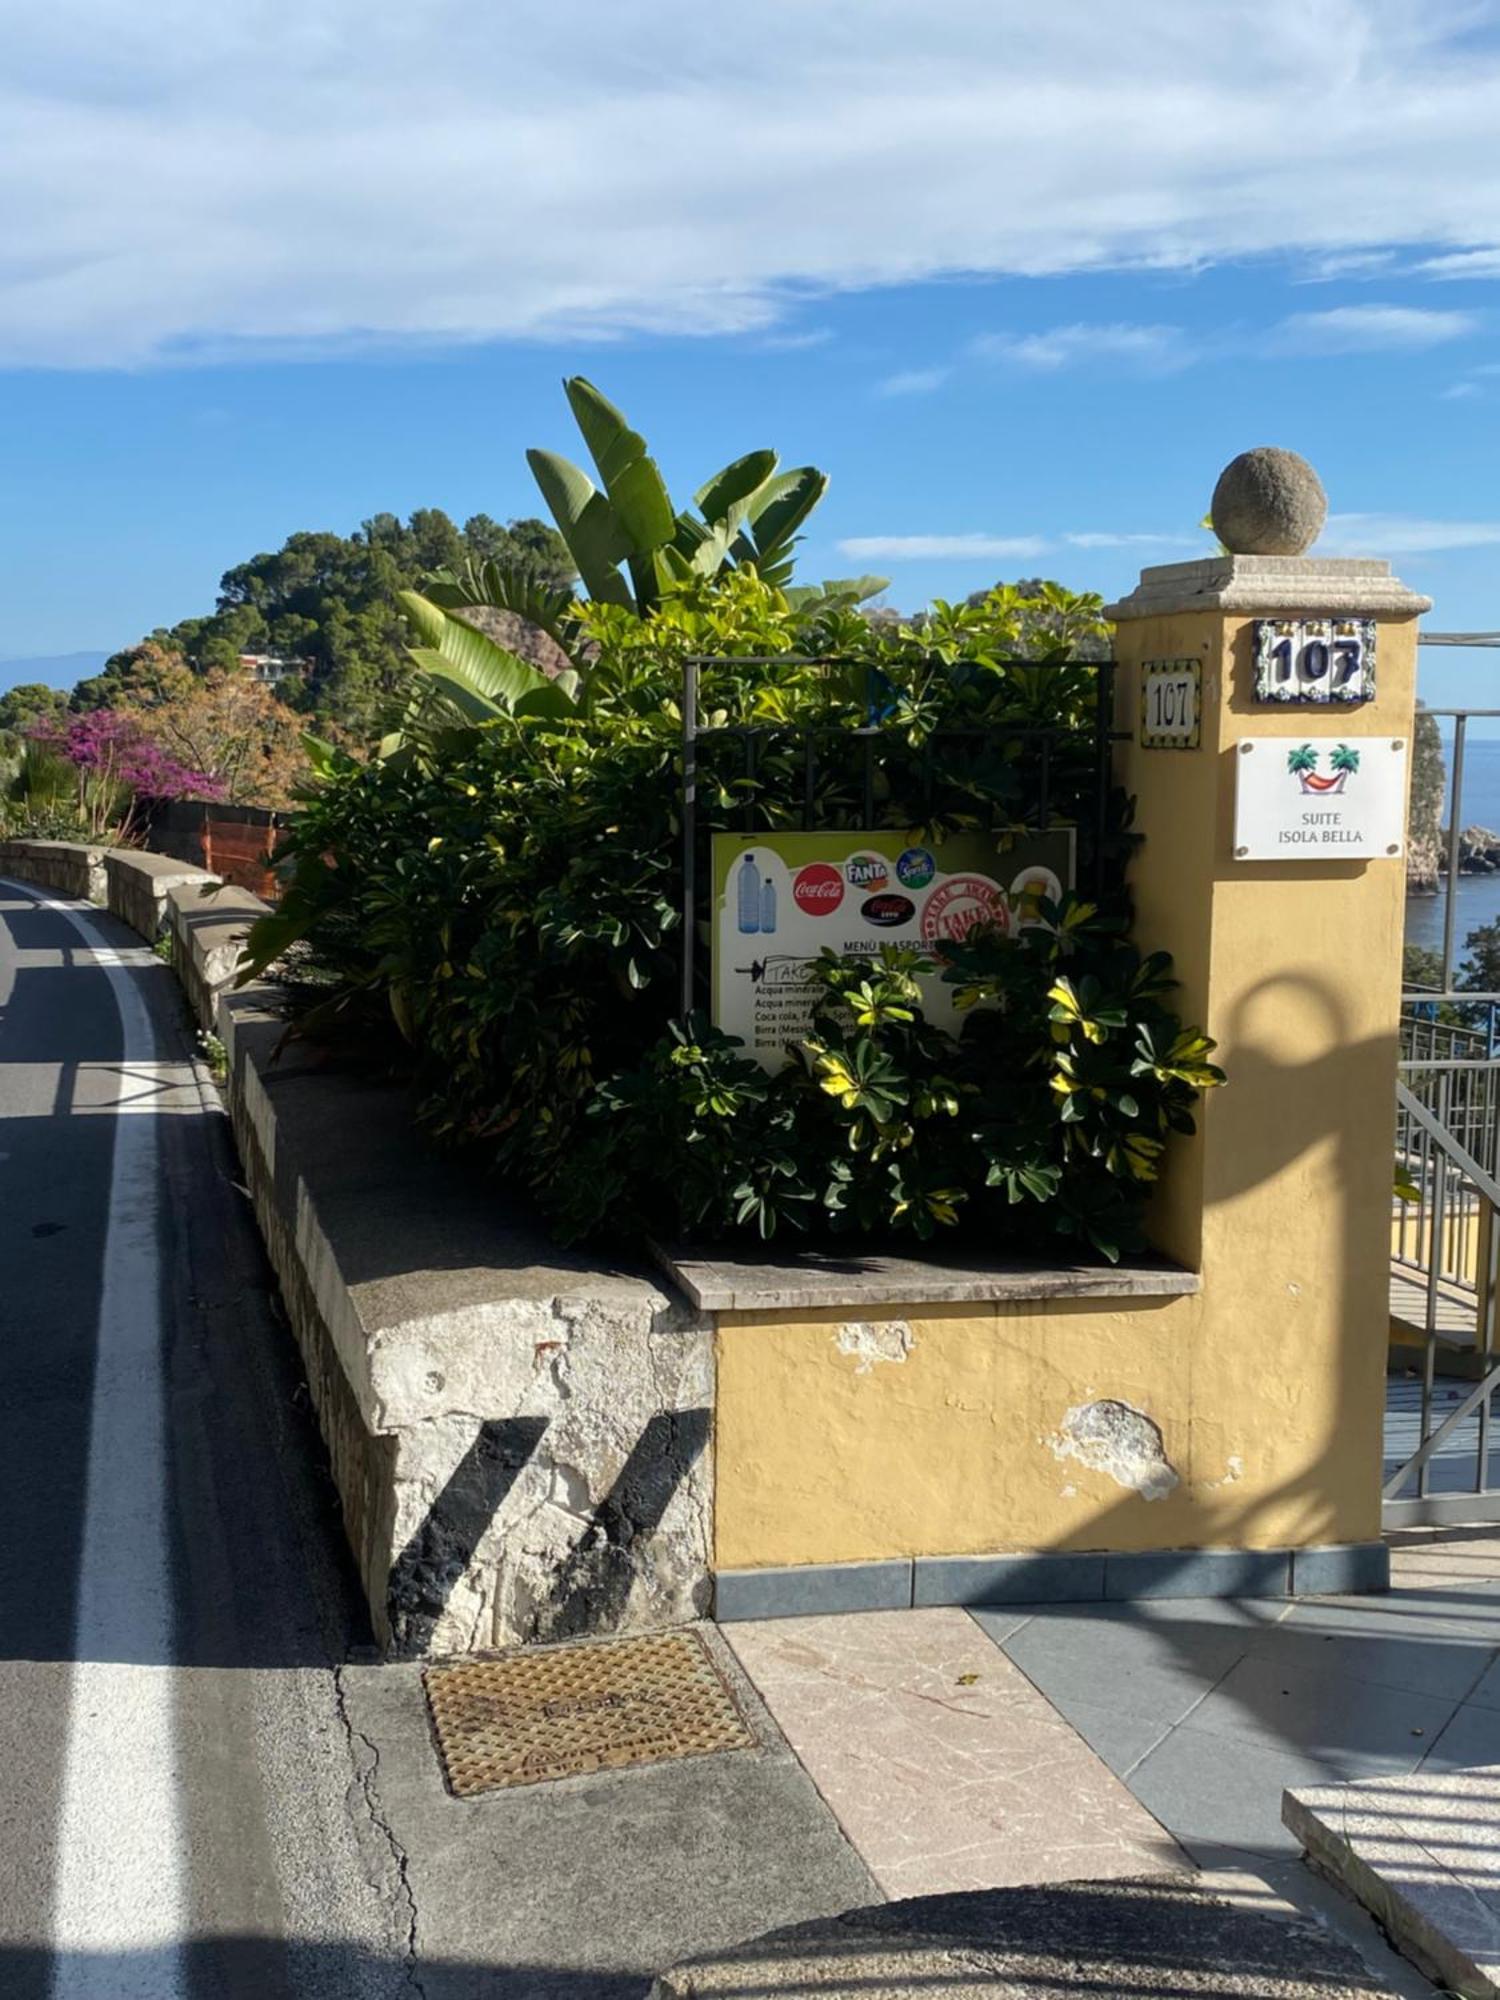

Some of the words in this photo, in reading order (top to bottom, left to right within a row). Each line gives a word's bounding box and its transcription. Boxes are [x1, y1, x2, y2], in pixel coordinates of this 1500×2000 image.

[1270, 638, 1361, 685] 107
[1153, 682, 1188, 726] 107
[1302, 813, 1342, 825] SUITE
[1279, 831, 1318, 843] ISOLA
[1322, 830, 1363, 842] BELLA
[755, 987, 782, 996] Acqua
[785, 986, 824, 994] minerale
[755, 1000, 782, 1009] Acqua
[755, 1012, 776, 1021] Coca
[755, 1026, 776, 1034] Birra
